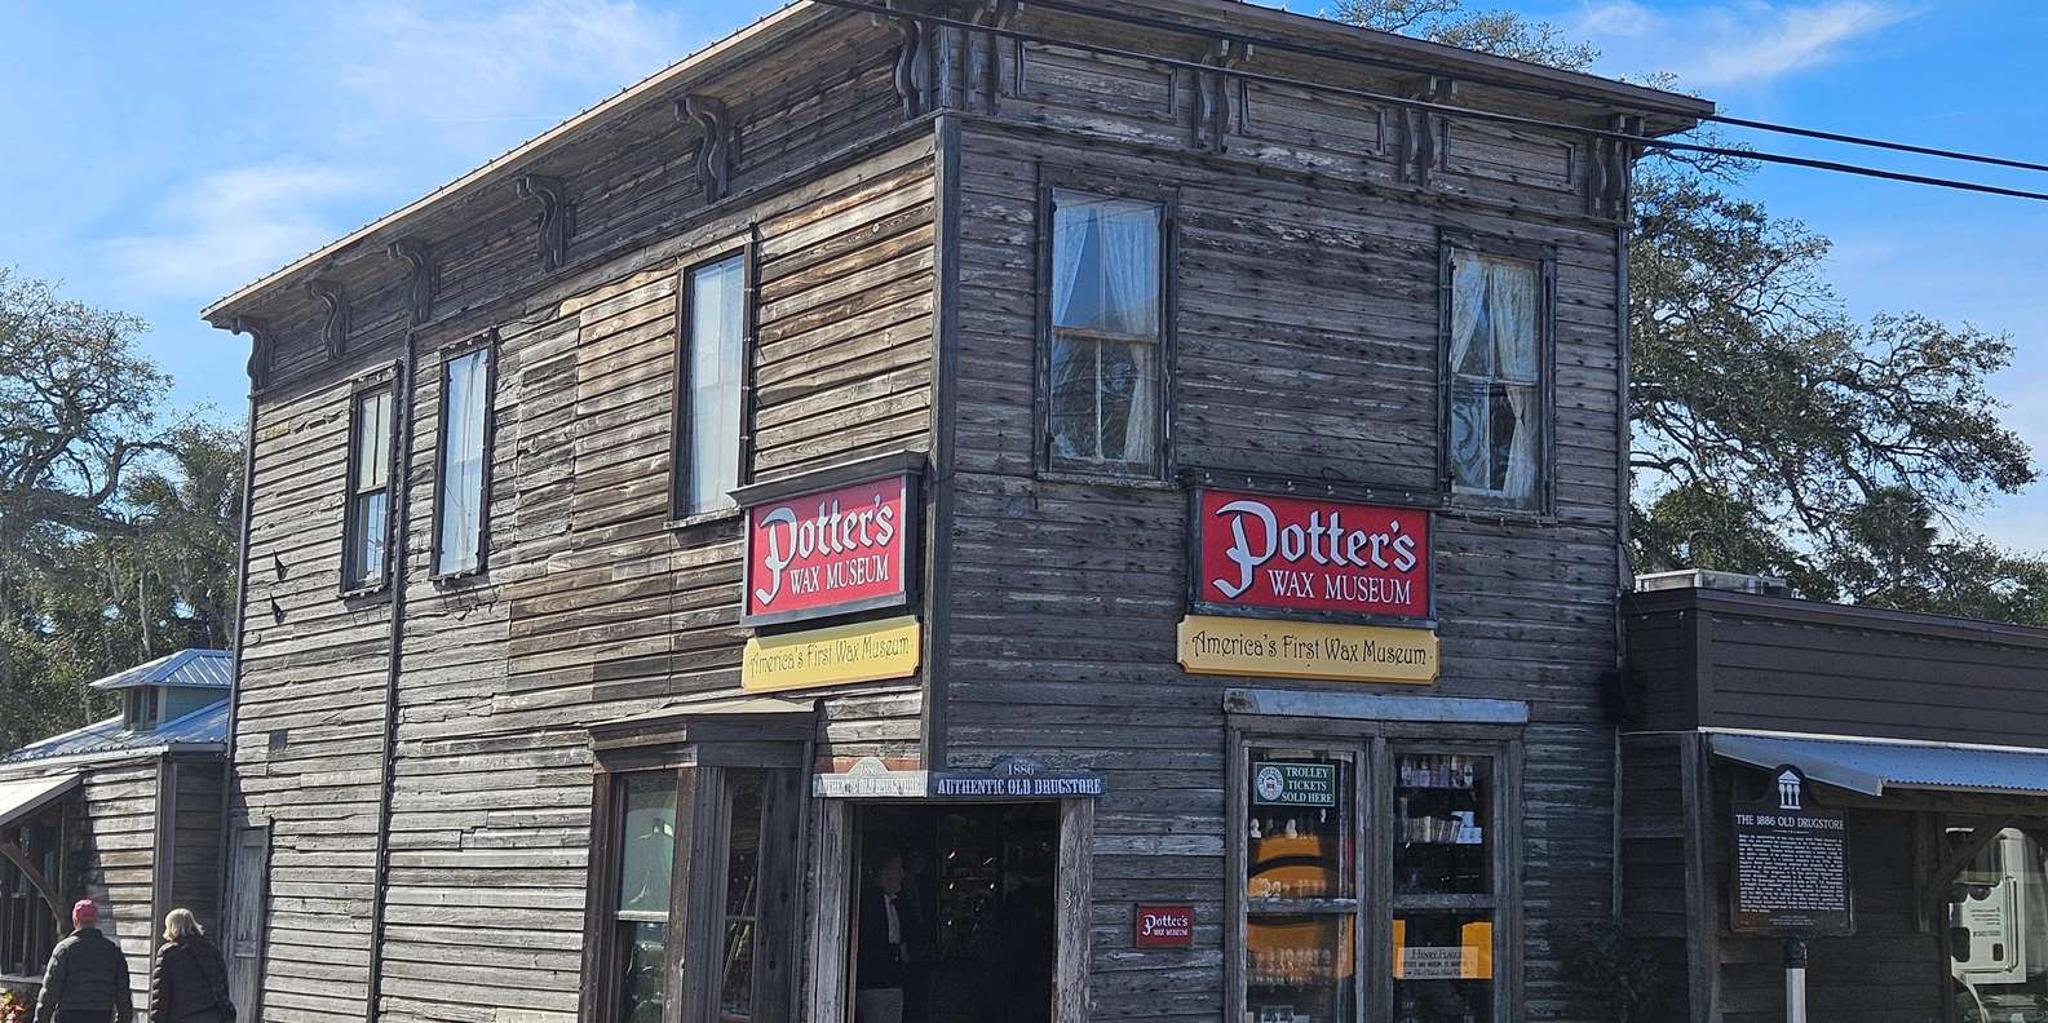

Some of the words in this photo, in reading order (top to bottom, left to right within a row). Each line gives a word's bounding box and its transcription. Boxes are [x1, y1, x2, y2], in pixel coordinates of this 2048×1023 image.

[755, 494, 895, 606] Potter's
[1212, 500, 1417, 598] Potter's
[790, 566, 821, 596] WAX
[826, 554, 889, 590] MUSEUM
[1268, 569, 1315, 598] WAX
[1325, 574, 1411, 604] MUSEUM
[750, 645, 804, 677] America's
[807, 643, 832, 669] First
[836, 638, 859, 664] Wax
[861, 634, 909, 660] Museum
[1192, 631, 1278, 657] America's
[1283, 635, 1319, 659] First
[1325, 637, 1358, 662] Wax
[1362, 640, 1427, 665] Museum
[1008, 763, 1035, 776] 1886
[1286, 767, 1328, 778] TROLLEY
[937, 778, 1005, 794] AUTHENTIC
[1007, 779, 1031, 794] OLD
[1034, 779, 1101, 794] DRUGSTORE
[1288, 780, 1327, 791] TICKETS
[1281, 792, 1307, 802] SOLD
[1308, 793, 1333, 803] HERE
[1736, 815, 1754, 825] THE
[1756, 815, 1775, 826] 1886
[1777, 817, 1796, 828] OLD
[1797, 818, 1843, 830] DRUGSTORE
[1142, 914, 1188, 936] Potter's
